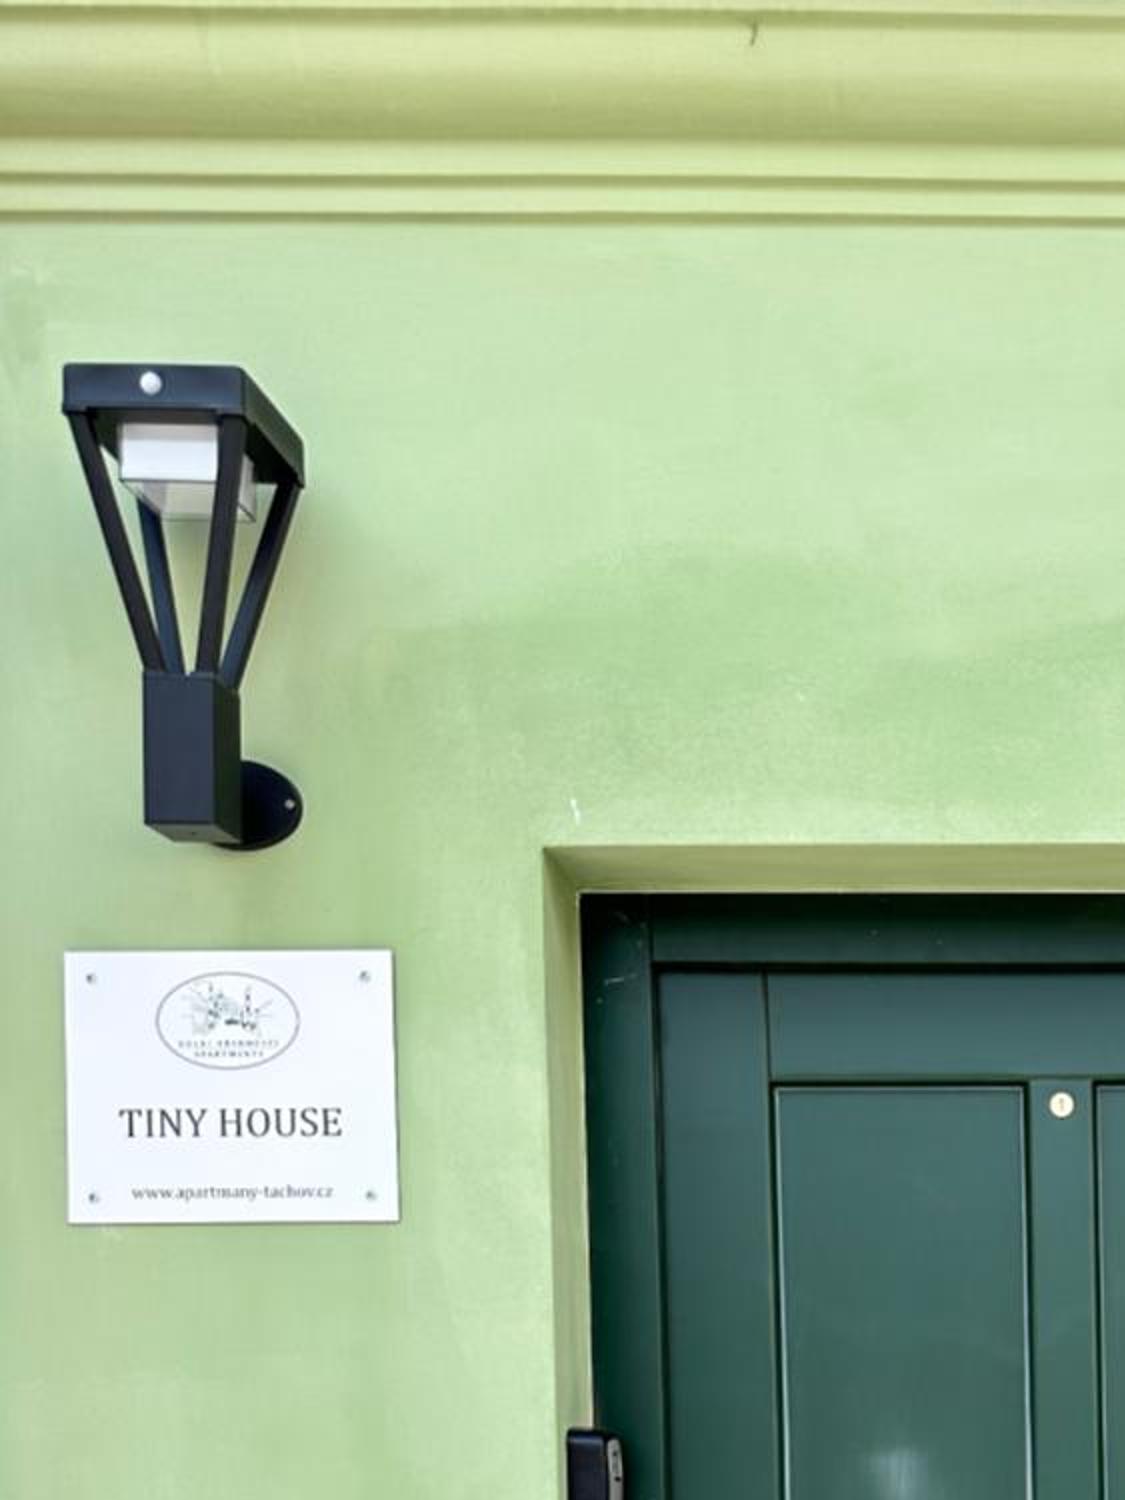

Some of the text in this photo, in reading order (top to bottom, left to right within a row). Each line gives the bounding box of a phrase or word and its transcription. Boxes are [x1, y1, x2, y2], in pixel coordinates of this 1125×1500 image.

[118, 1107, 343, 1139] TINY HOUSE
[131, 1183, 334, 1203] www.apartmany-tachov.cz
